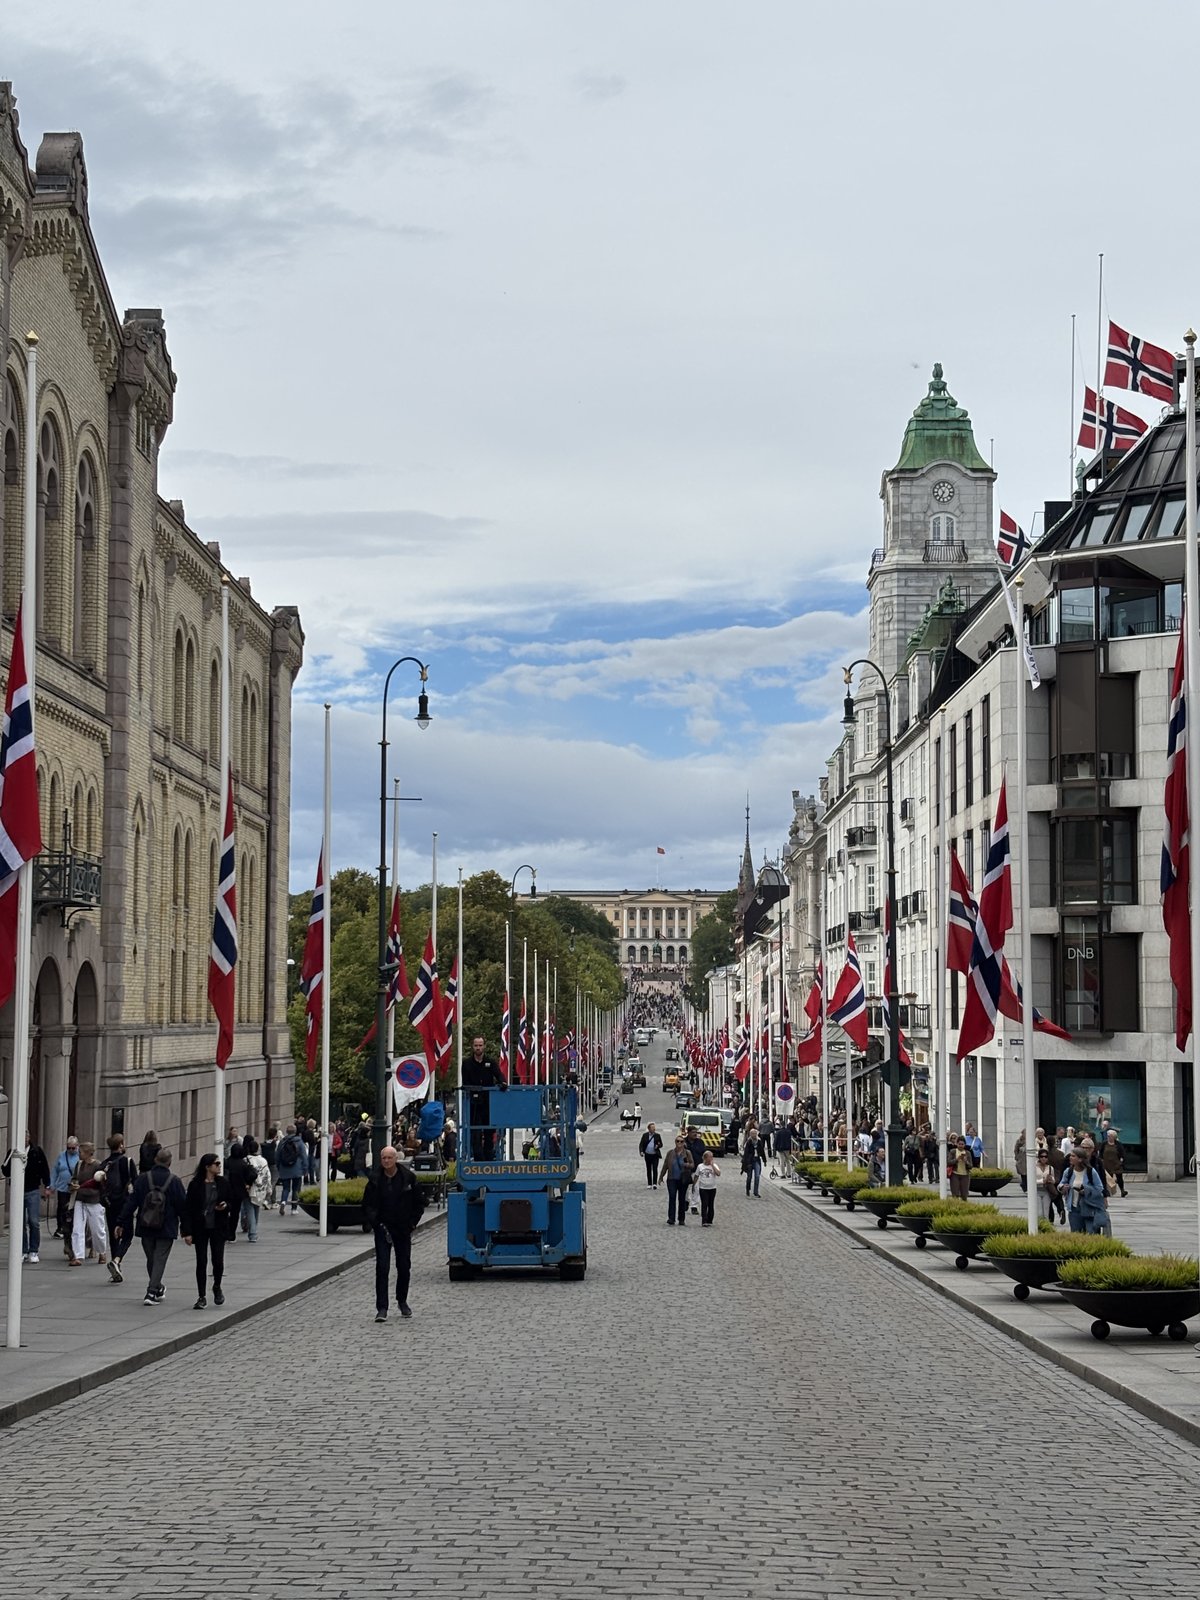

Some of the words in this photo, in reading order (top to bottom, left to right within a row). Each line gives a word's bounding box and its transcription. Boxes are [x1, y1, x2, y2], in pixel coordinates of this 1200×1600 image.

[857, 943, 873, 954] OTEL
[1067, 947, 1095, 960] DNB
[463, 1164, 569, 1175] OSLOLIFTUTLEIE.NO
